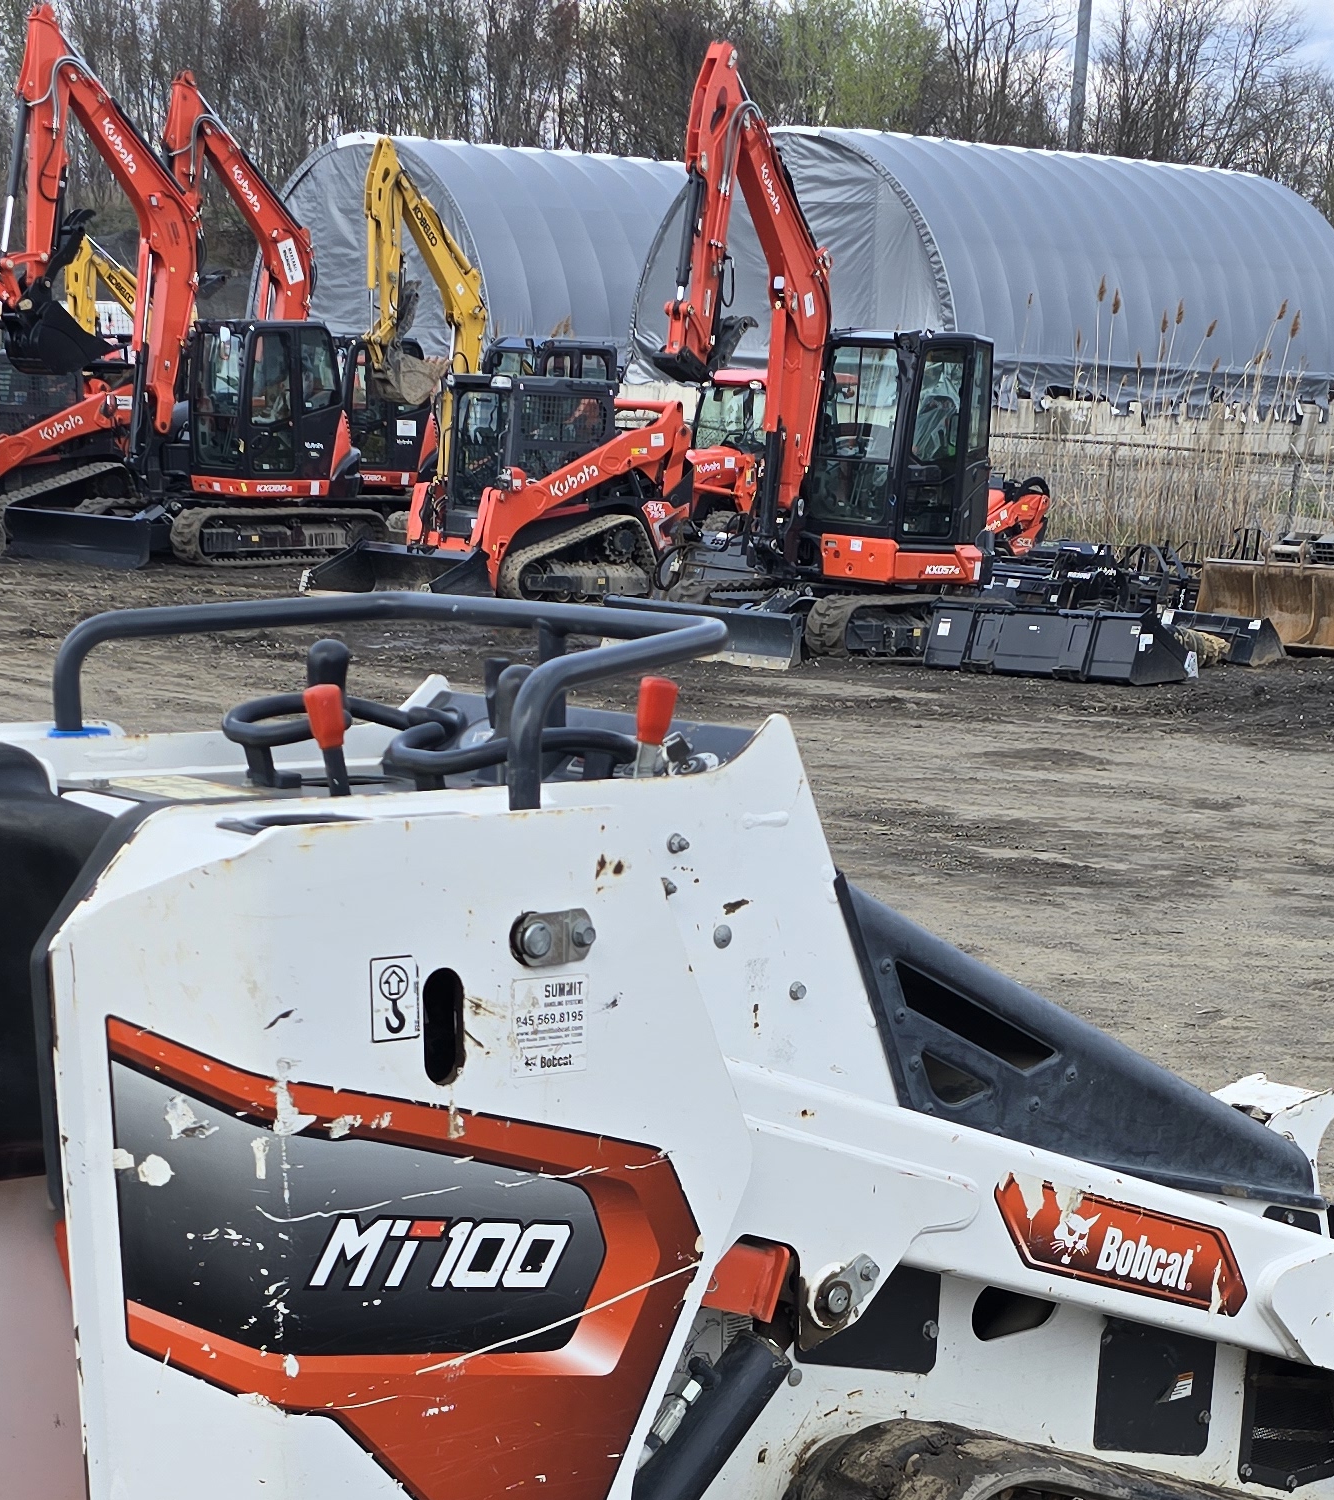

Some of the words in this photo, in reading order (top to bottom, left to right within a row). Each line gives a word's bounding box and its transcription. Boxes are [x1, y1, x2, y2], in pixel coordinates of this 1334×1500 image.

[102, 117, 137, 175] Kubota
[232, 165, 261, 213] Kubota
[761, 162, 781, 216] Kubota
[412, 203, 438, 247] KOBELCO
[106, 272, 135, 305] KOBELCO
[39, 414, 84, 441] Kubota
[549, 464, 599, 498] Kubota
[696, 460, 721, 474] Kubota
[544, 981, 583, 998] SUMMIT
[309, 1217, 571, 1289] MT100
[1096, 1226, 1194, 1291] Bobcat
